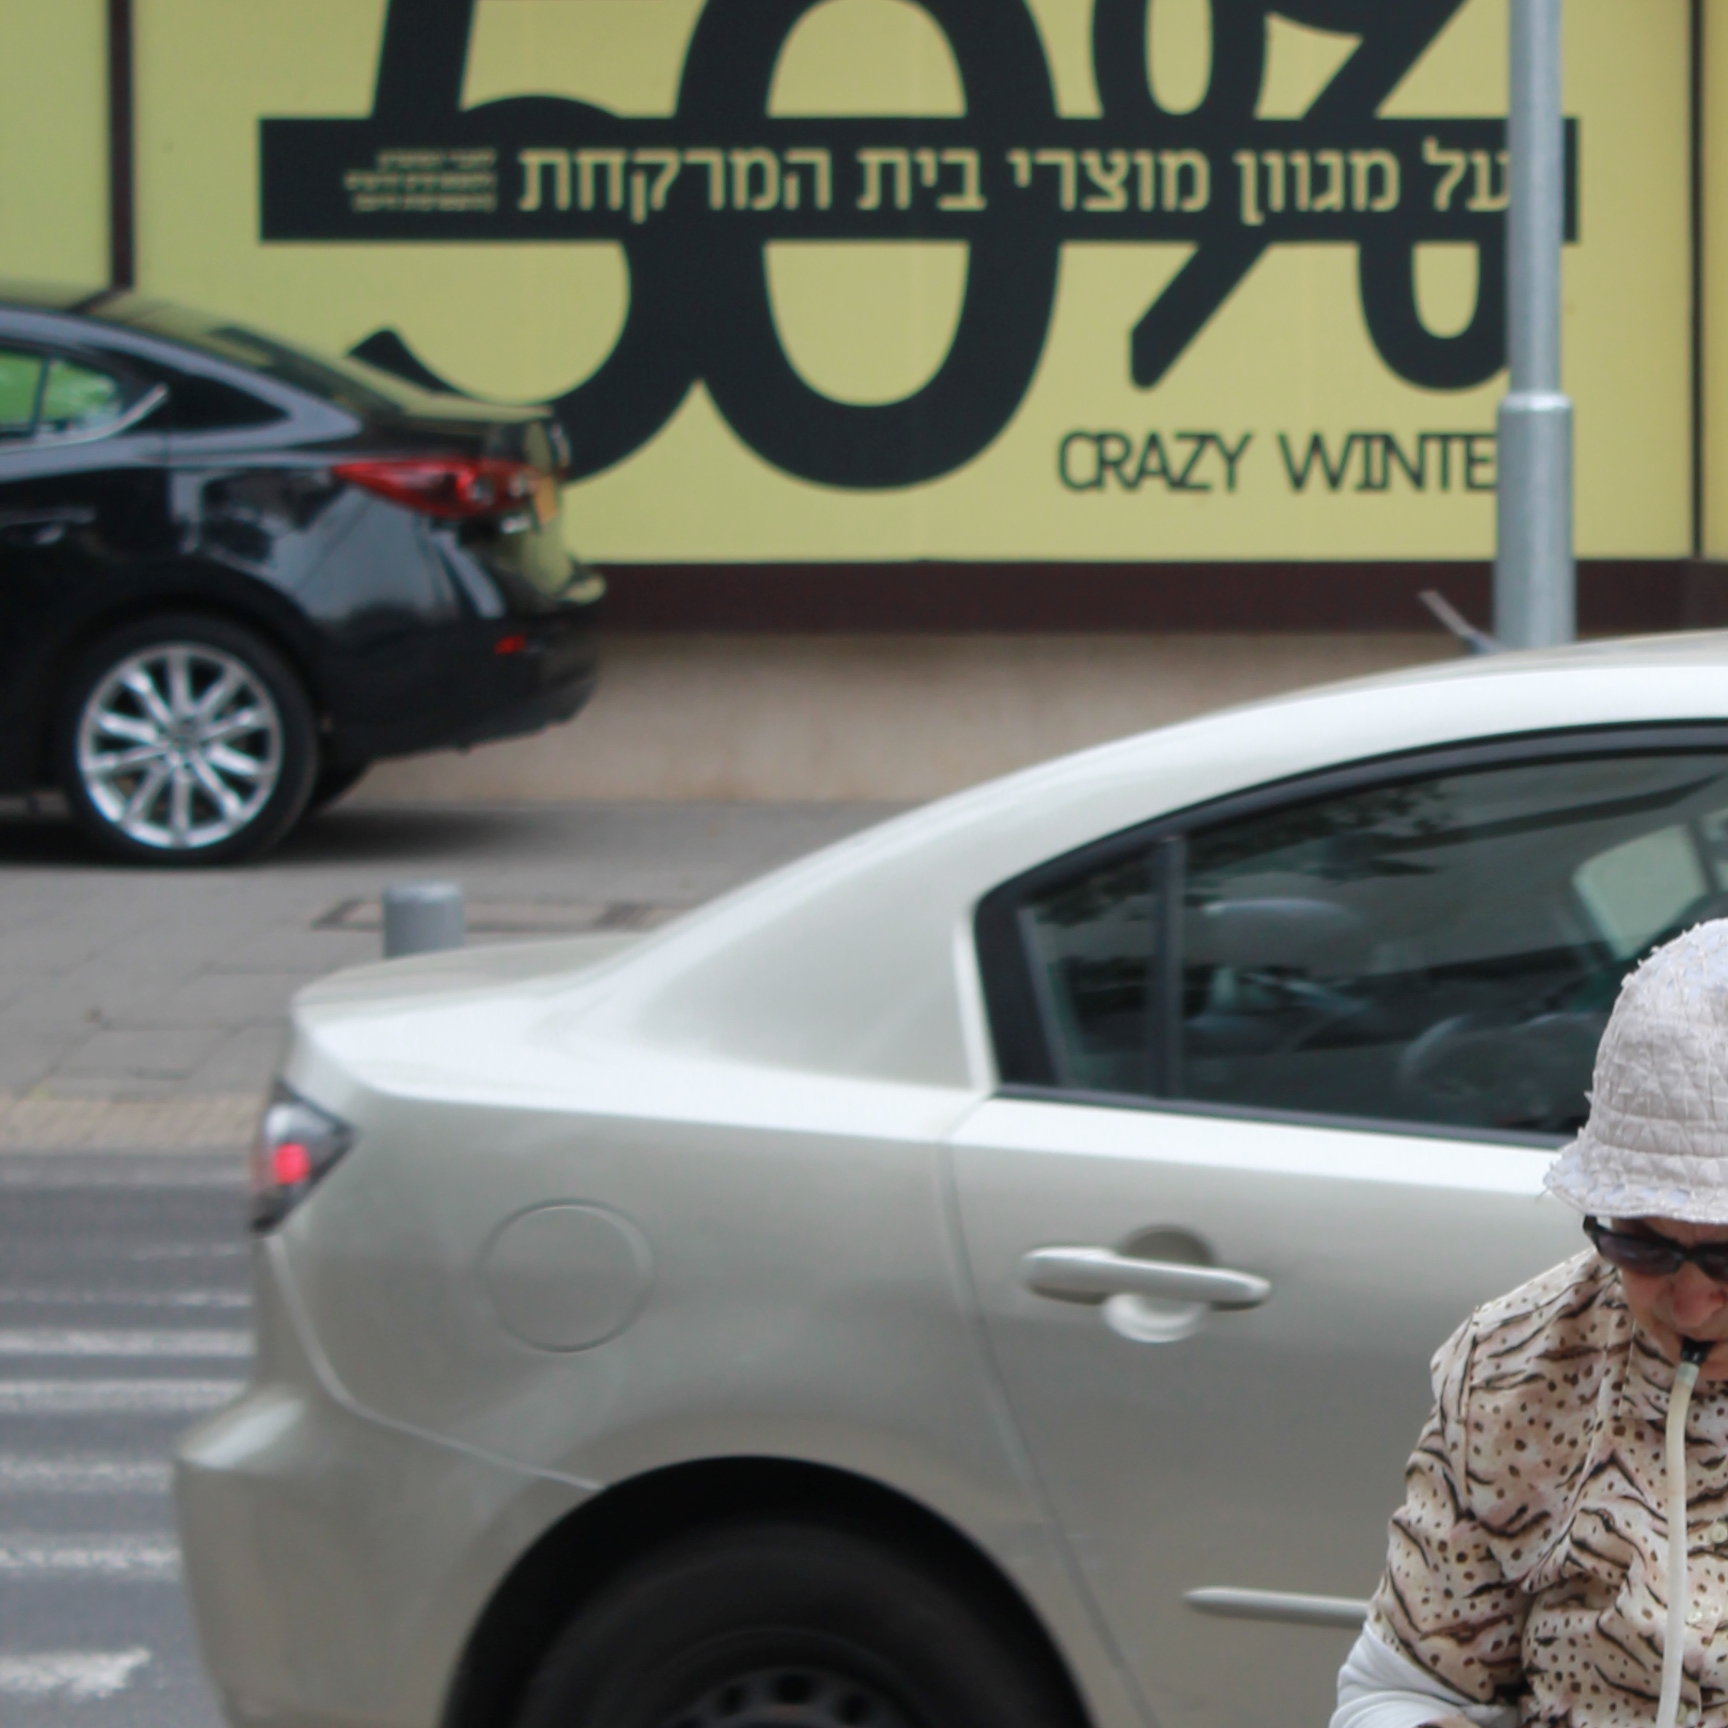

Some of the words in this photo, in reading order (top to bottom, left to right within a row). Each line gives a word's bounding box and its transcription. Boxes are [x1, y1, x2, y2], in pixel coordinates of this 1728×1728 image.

[518, 147, 832, 225] המרקחת
[857, 147, 988, 213] בית
[1006, 147, 1212, 213] מוצרי
[1232, 146, 1401, 227] מגוון
[1057, 429, 1253, 494] CRAZY
